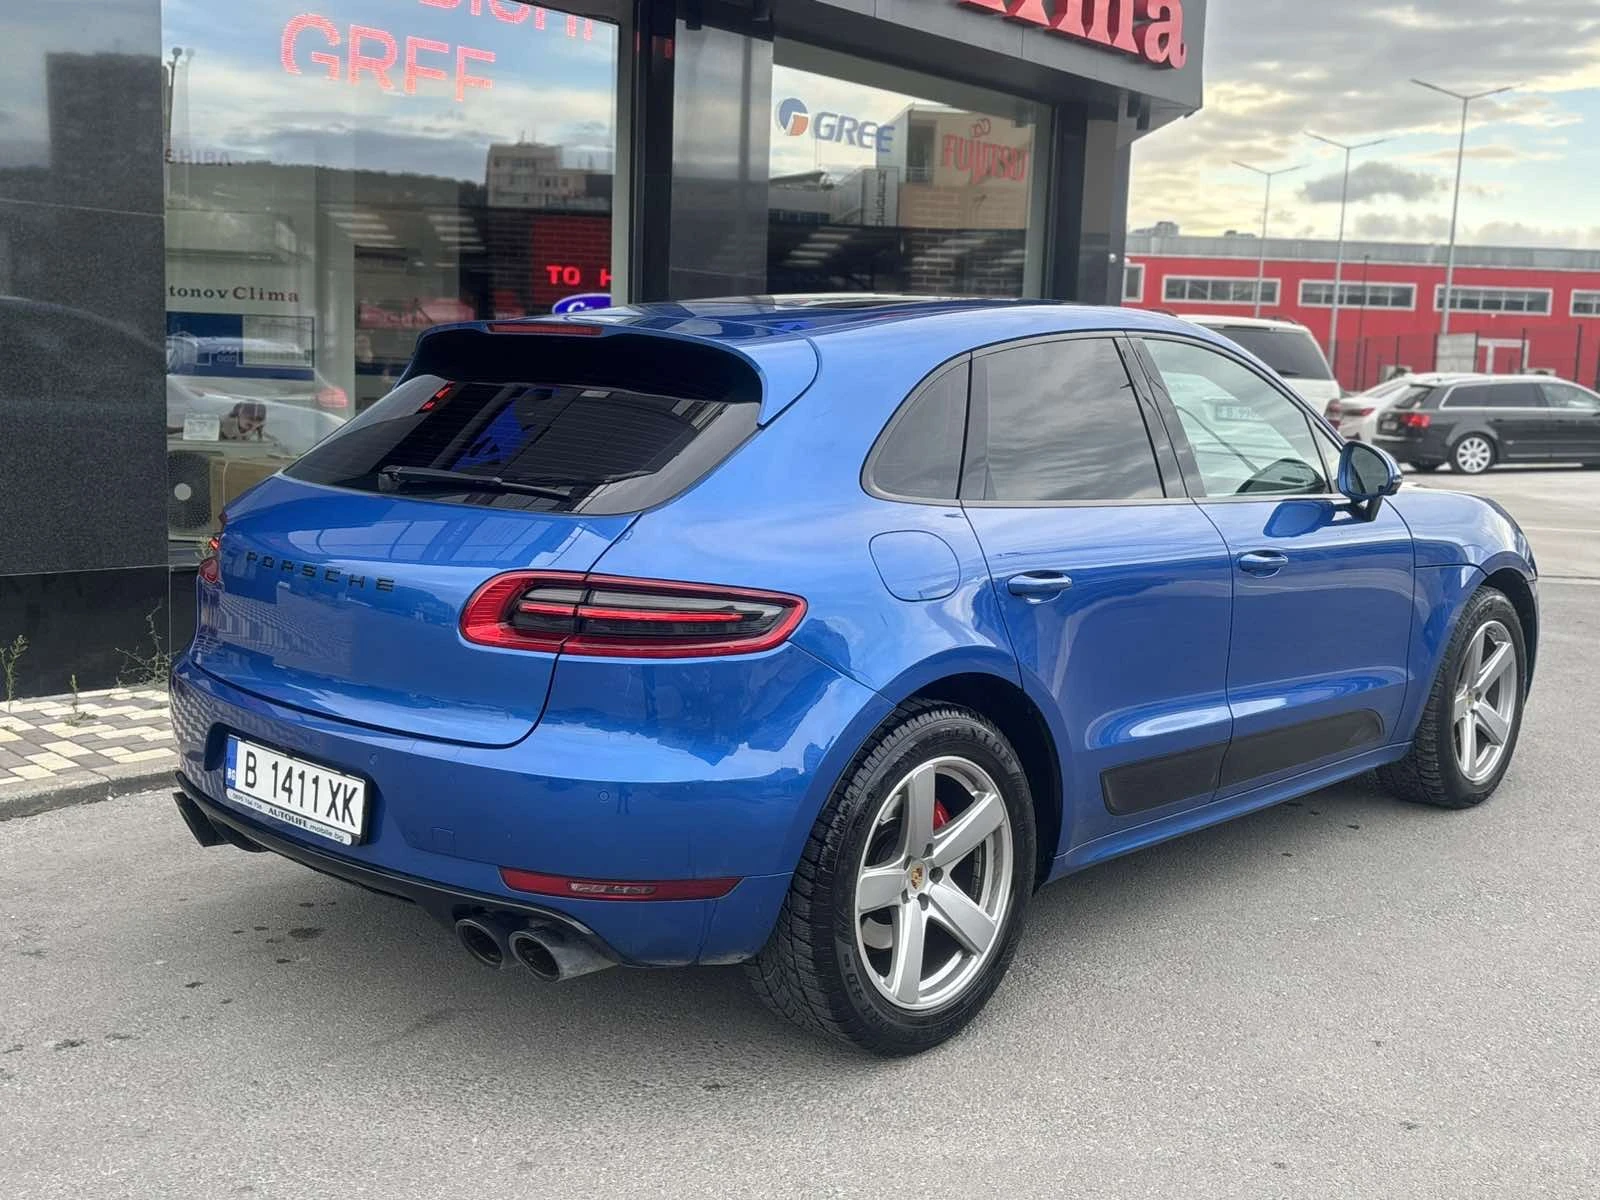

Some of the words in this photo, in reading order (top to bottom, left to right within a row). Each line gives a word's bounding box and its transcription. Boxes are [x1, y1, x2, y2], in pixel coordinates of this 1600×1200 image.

[813, 111, 896, 153] GREE
[942, 134, 1029, 185] FUJITSU
[546, 265, 580, 285] TO
[246, 551, 395, 593] PORSCHE
[244, 750, 257, 789] B
[267, 806, 309, 828] AUTOLIFE
